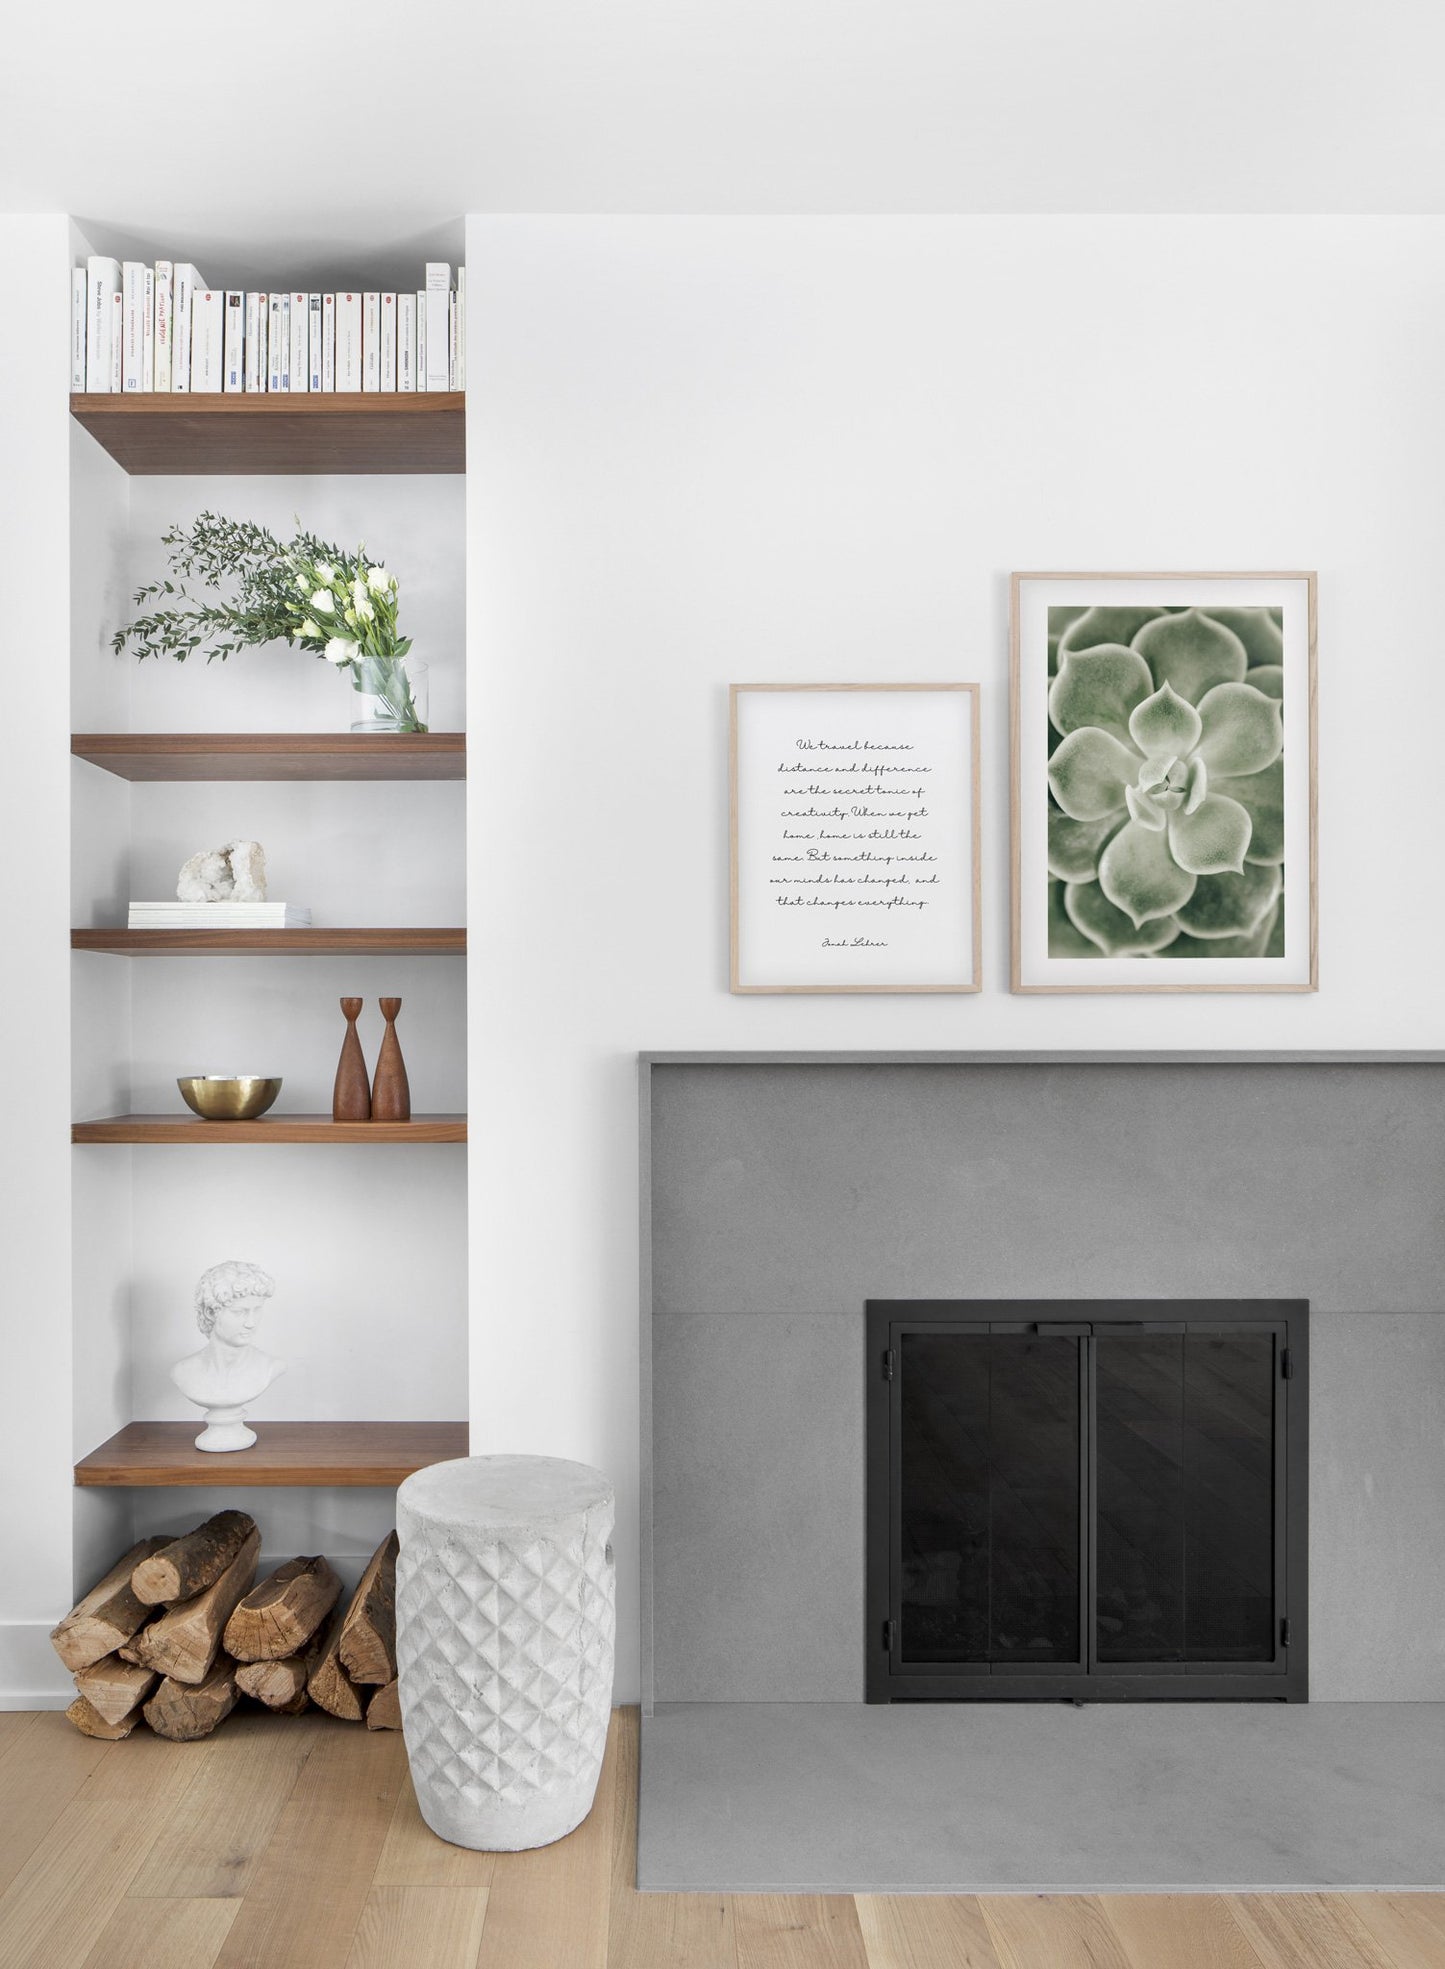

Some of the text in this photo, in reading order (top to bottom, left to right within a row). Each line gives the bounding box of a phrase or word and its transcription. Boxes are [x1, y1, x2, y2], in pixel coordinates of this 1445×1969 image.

[796, 738, 914, 751] We travel because
[777, 763, 932, 776] distance and difference
[784, 785, 925, 798] are the secret tonic of
[851, 806, 888, 817] When
[907, 807, 928, 820] get
[868, 829, 898, 839] still
[898, 829, 922, 839] the
[806, 848, 831, 862] But
[833, 851, 894, 865] something
[896, 852, 938, 861] inside
[794, 874, 832, 884] minds
[834, 874, 856, 883] has
[915, 874, 940, 883] and
[776, 896, 805, 906] that
[806, 896, 856, 910] changes
